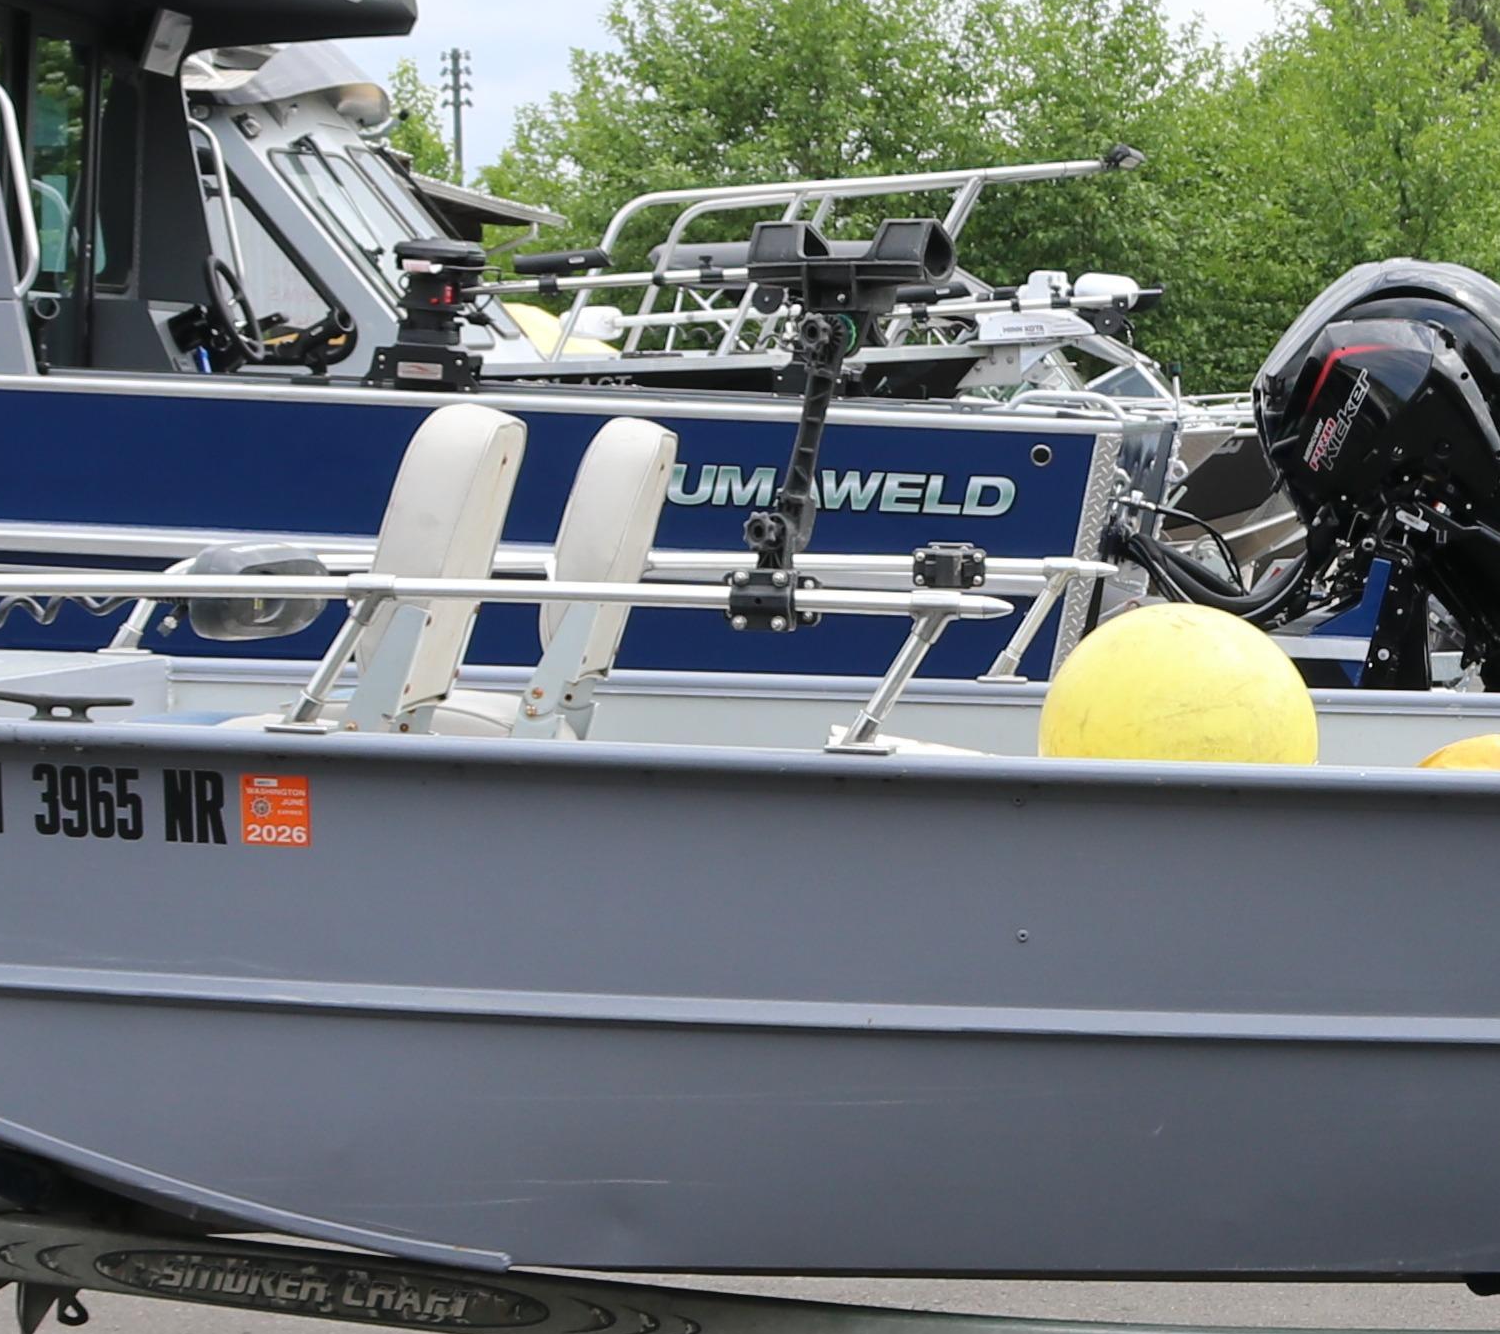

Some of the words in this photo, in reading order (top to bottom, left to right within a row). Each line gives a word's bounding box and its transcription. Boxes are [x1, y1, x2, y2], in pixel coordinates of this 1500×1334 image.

[33, 763, 144, 841] 3965
[162, 768, 228, 845] NR
[245, 787, 307, 797] WASHINGTON
[246, 823, 308, 844] 2026
[157, 1260, 331, 1307] SMOKER
